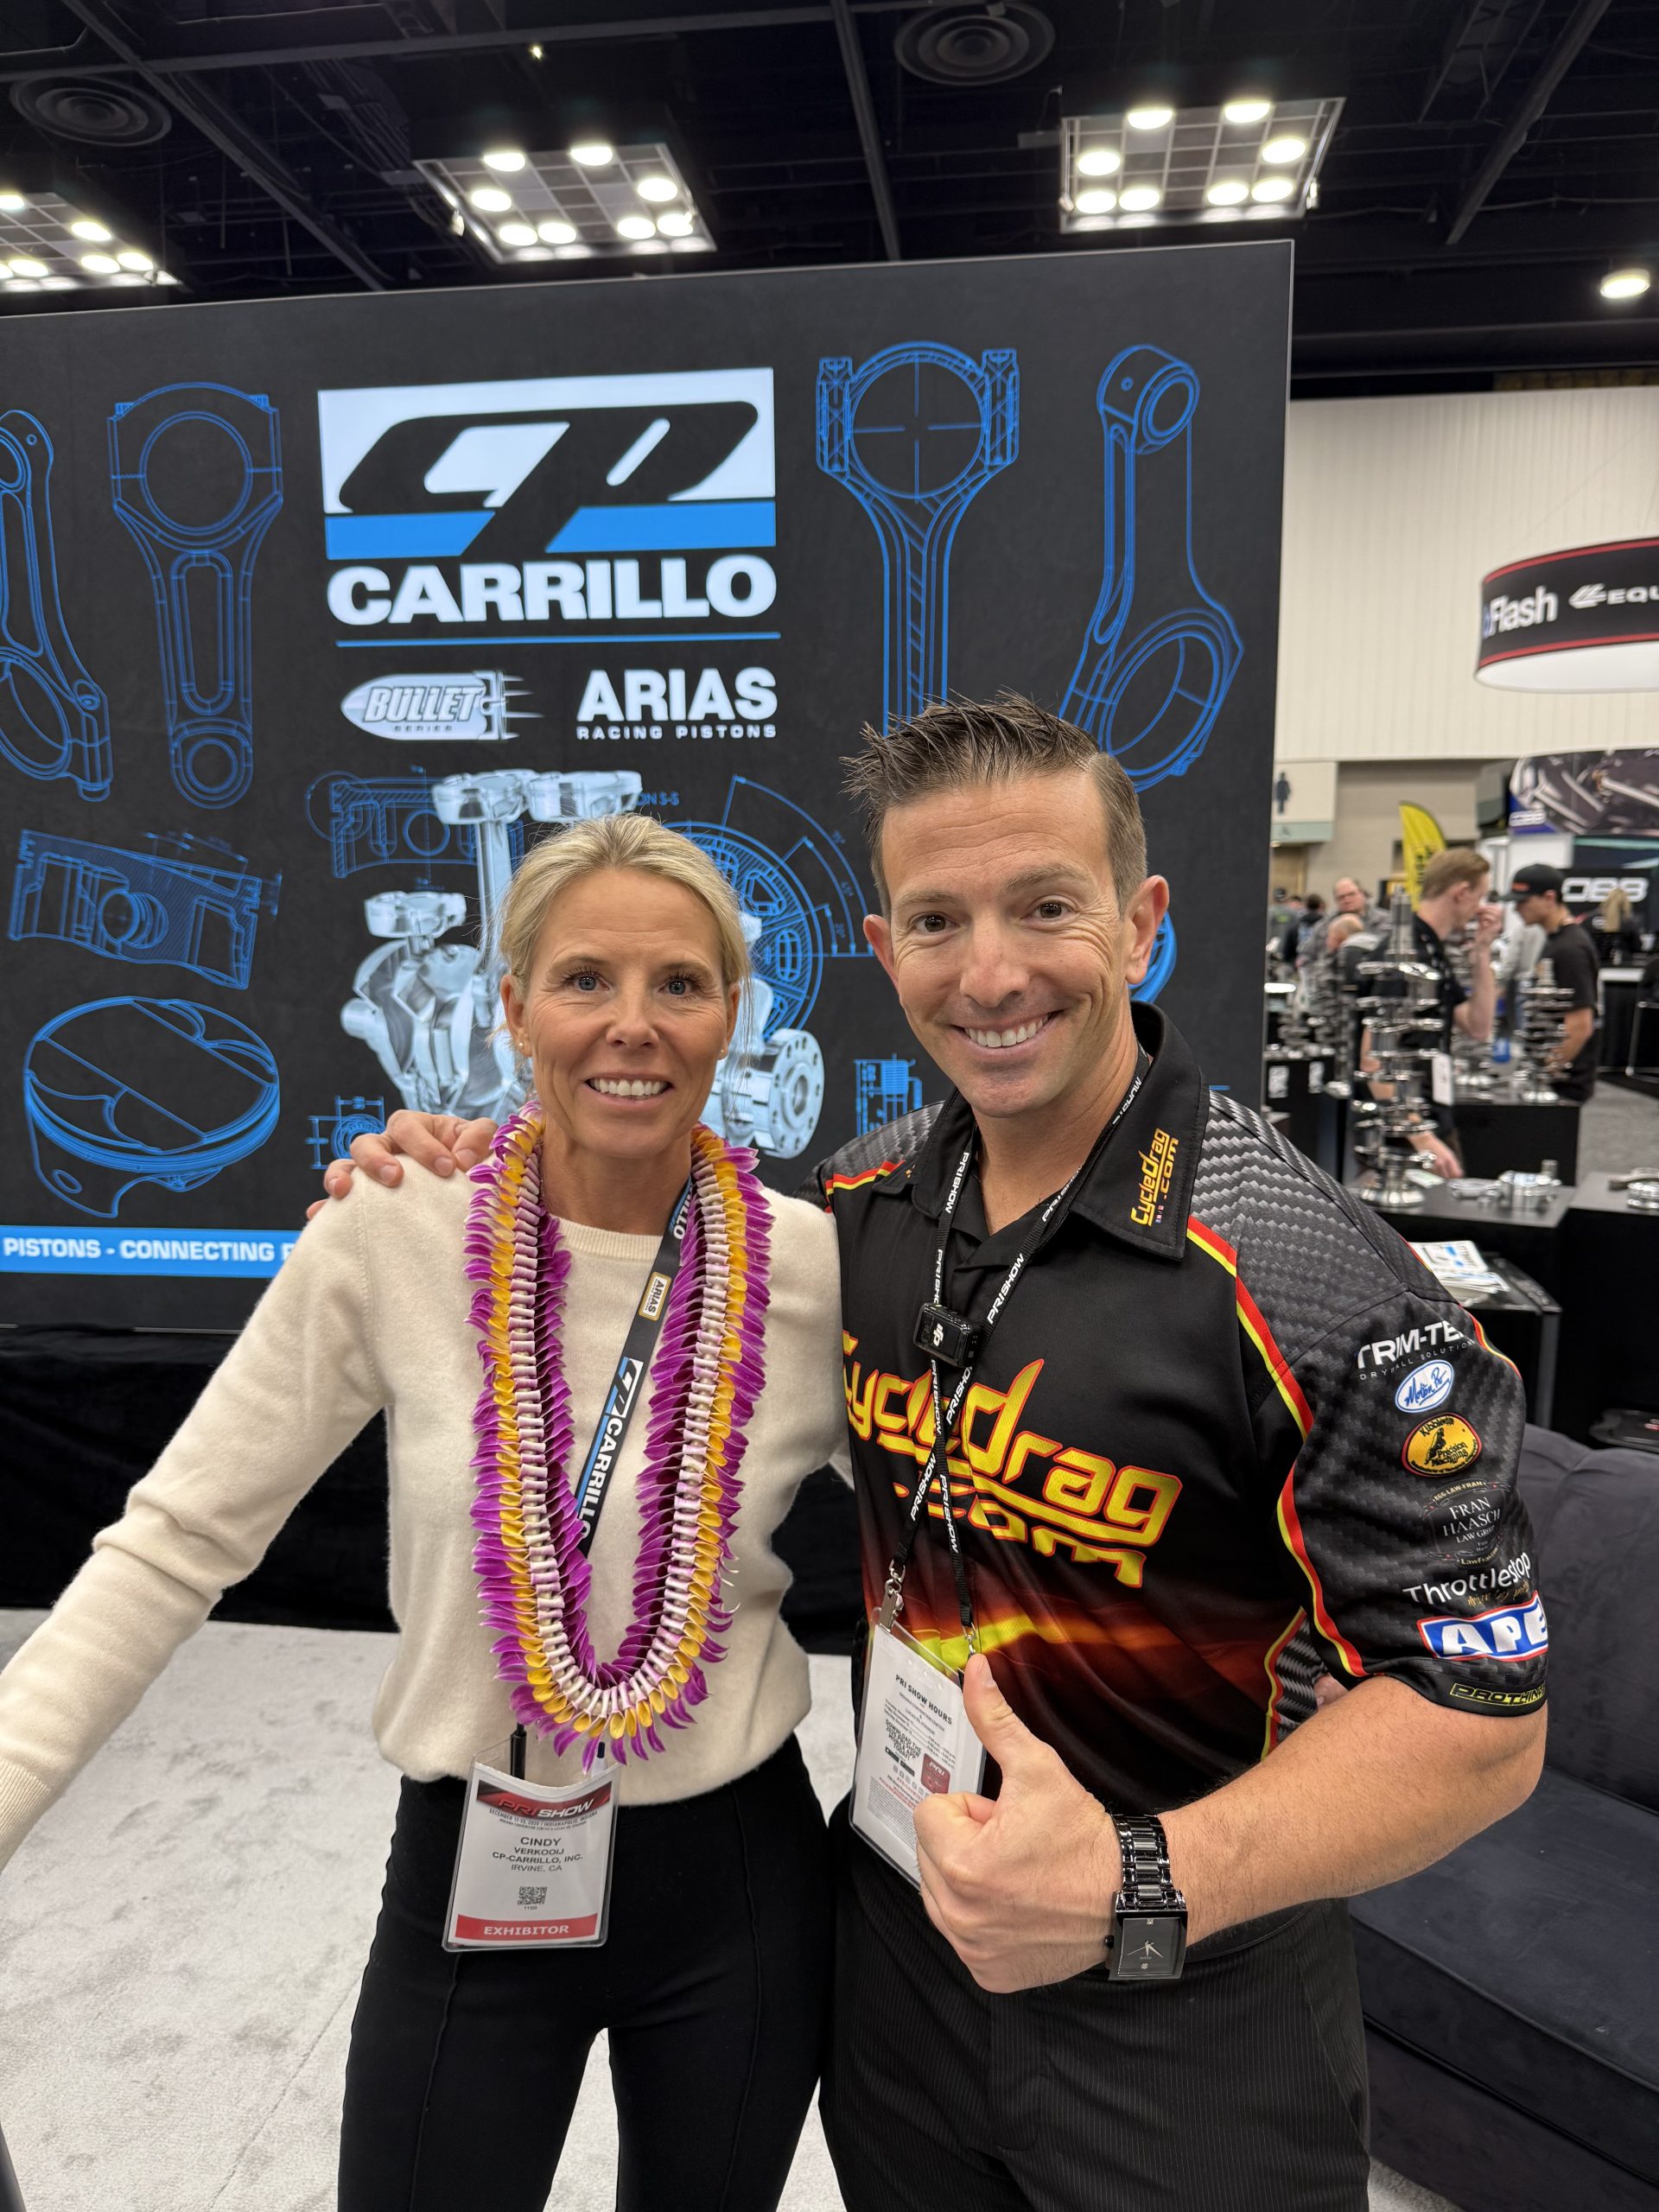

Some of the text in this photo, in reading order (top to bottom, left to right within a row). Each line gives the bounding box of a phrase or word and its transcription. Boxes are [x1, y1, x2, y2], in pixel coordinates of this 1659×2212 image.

[327, 554, 778, 626] CARRILLO
[363, 686, 485, 723] BULLET
[575, 666, 778, 722] ARIAS
[393, 724, 453, 733] SERIES
[576, 723, 777, 741] RACING PISTONS
[3, 1238, 101, 1259] PISTONS
[120, 1240, 276, 1262] CONNECTING
[648, 1280, 664, 1313] ARIAS
[987, 1253, 1025, 1325] PRISHOW
[1357, 1320, 1465, 1370] TRIM-TE
[945, 1365, 973, 1425] PRISHO
[579, 1417, 623, 1539] CARRILLO
[910, 1453, 937, 1522] PRISHOW
[1443, 1509, 1500, 1536] HAASCH
[1449, 1497, 1491, 1520] FRAN
[1456, 1532, 1475, 1543] LAW
[1402, 1552, 1531, 1605] Throttlestop
[896, 1675, 906, 1688] PRI
[908, 1684, 927, 1705] SHOW
[929, 1701, 952, 1725] HOURS
[493, 1852, 562, 1864] CP-CARRILLO,
[514, 1847, 564, 1856] VERKOOIJ
[520, 1837, 562, 1847] CINDY
[483, 1925, 569, 1936] EXHIBITOR
